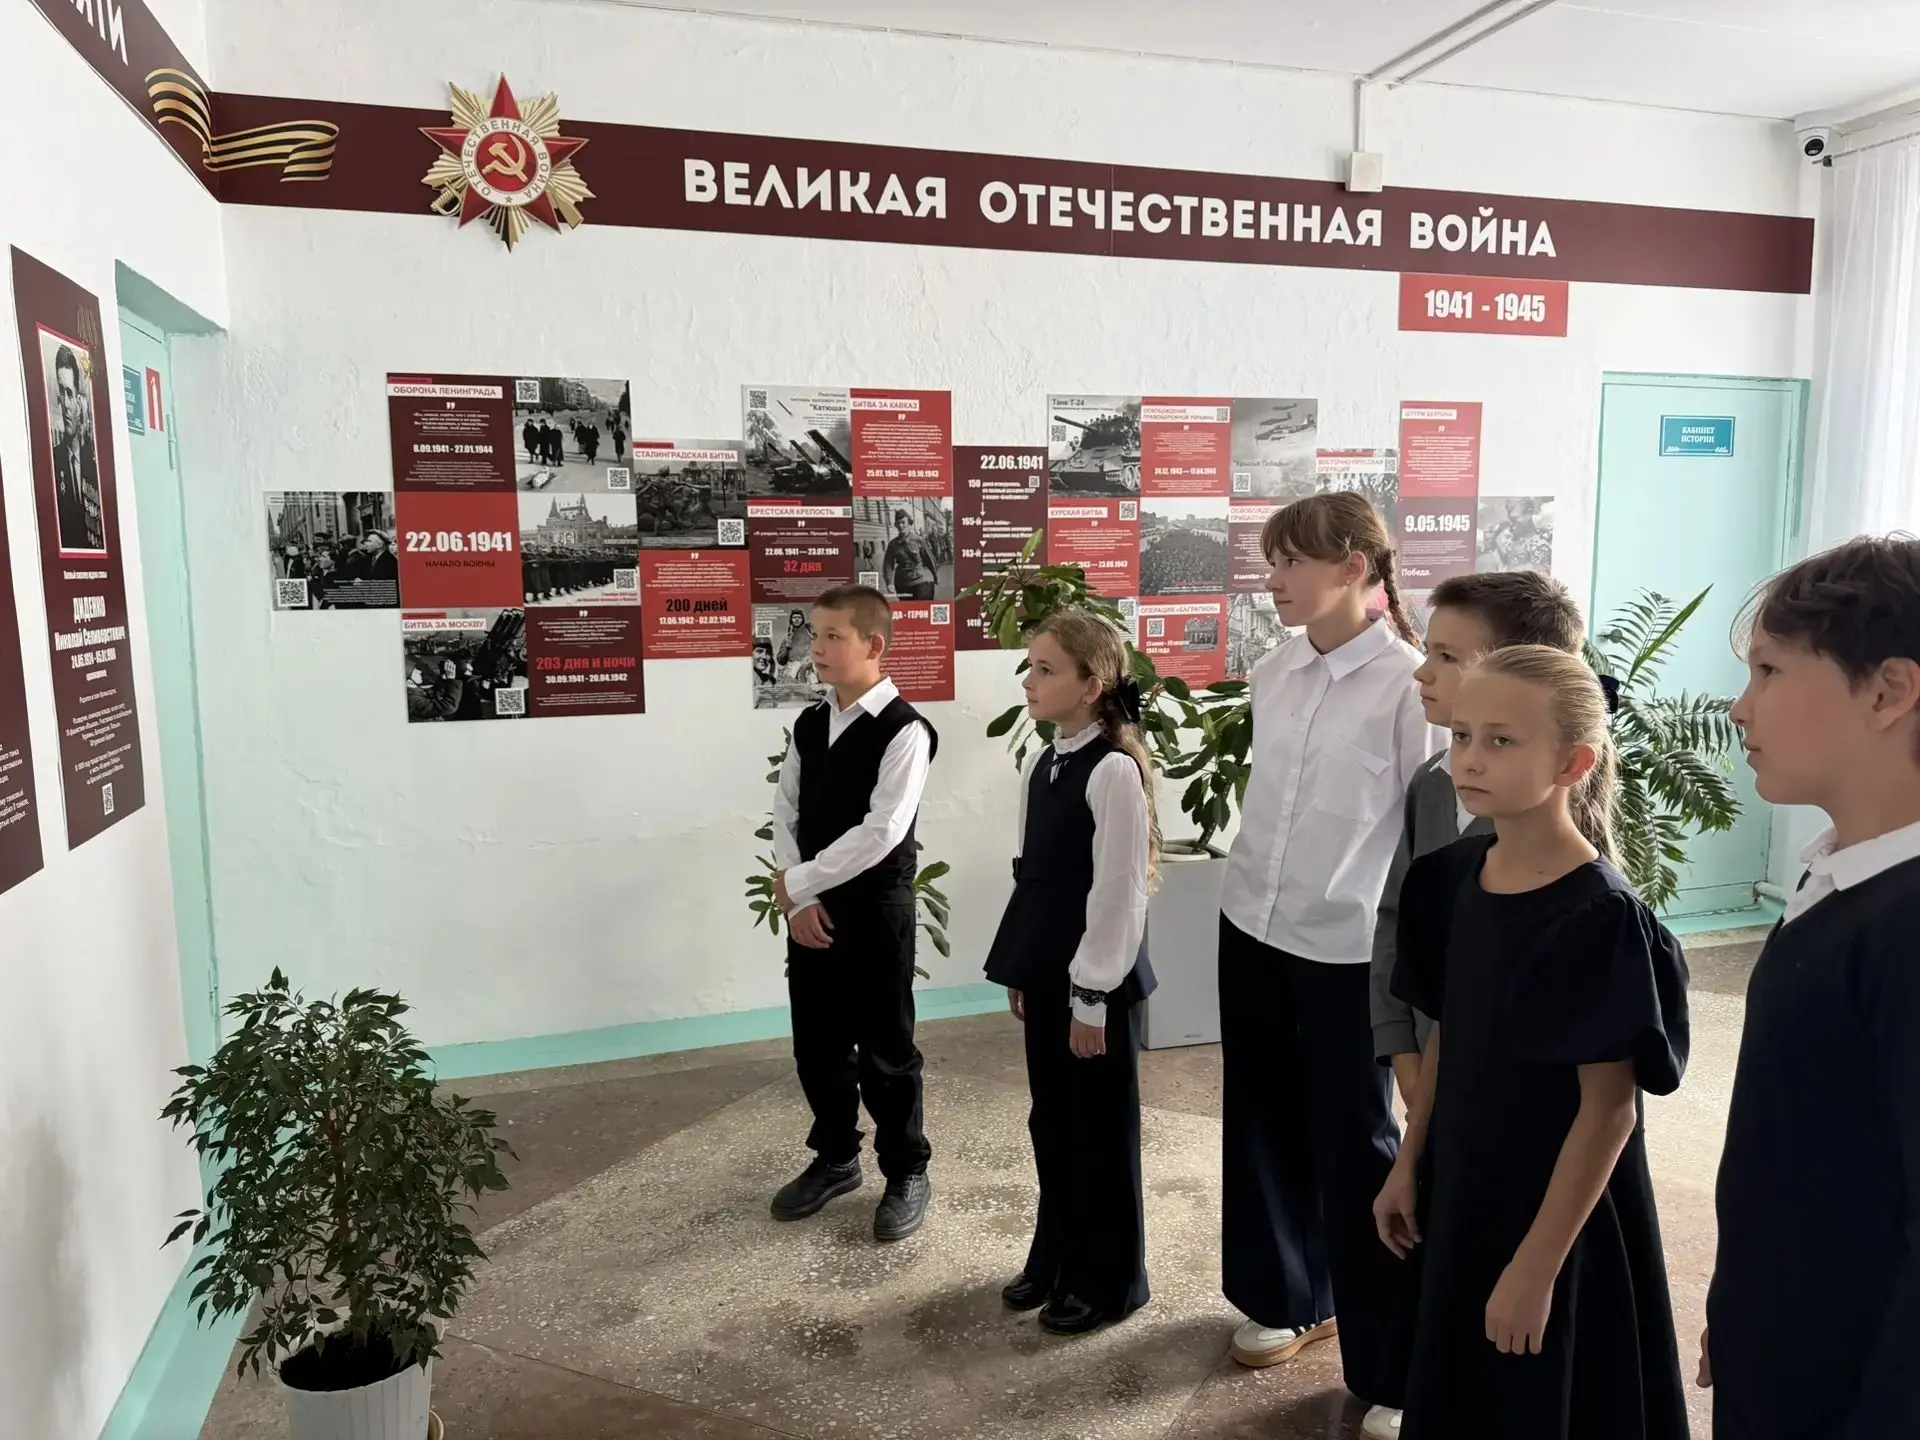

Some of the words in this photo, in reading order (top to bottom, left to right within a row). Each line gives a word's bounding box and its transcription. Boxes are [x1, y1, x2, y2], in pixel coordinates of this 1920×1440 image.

[463, 119, 539, 197] ОТЕЧЕСТВЕННАЯ
[683, 158, 948, 220] ВЕЛИКАЯ
[979, 180, 1383, 248] ОТЕЧЕСТВЕННАЯ
[1409, 206, 1557, 258] ВОЙНА
[1424, 289, 1473, 319] 1941
[1494, 292, 1546, 323] 1945
[393, 386, 438, 396] ОБОРОНА
[439, 386, 497, 397] ЛЕНИНГРАДА
[889, 401, 918, 409] КАВКАЗ
[1052, 398, 1069, 406] Танк
[1681, 426, 1716, 434] КАБИНЕТ
[1680, 435, 1715, 443] ИСТОРИИ
[413, 444, 449, 454] 8.09.1941
[454, 444, 494, 454] 27.01.1944
[635, 450, 708, 460] СТАЛИНГРАДСКАЯ
[709, 452, 736, 460] БИТВА
[980, 454, 1044, 470] 22.06.1941
[968, 479, 981, 488] 150
[1405, 514, 1470, 533] 9.05.1945
[405, 531, 513, 552] 22.06.1941
[425, 560, 461, 568] НАЧАЛО
[783, 560, 798, 572] 32
[799, 561, 822, 574] дня
[1401, 568, 1432, 577] Победа.
[666, 598, 691, 612] 200
[693, 597, 728, 613] дней
[404, 621, 434, 629] БИТВА
[435, 621, 446, 629] ЗА
[448, 620, 484, 629] МОСКВУ
[535, 656, 561, 670] 203
[563, 658, 590, 672] дня
[603, 656, 636, 668] ночи
